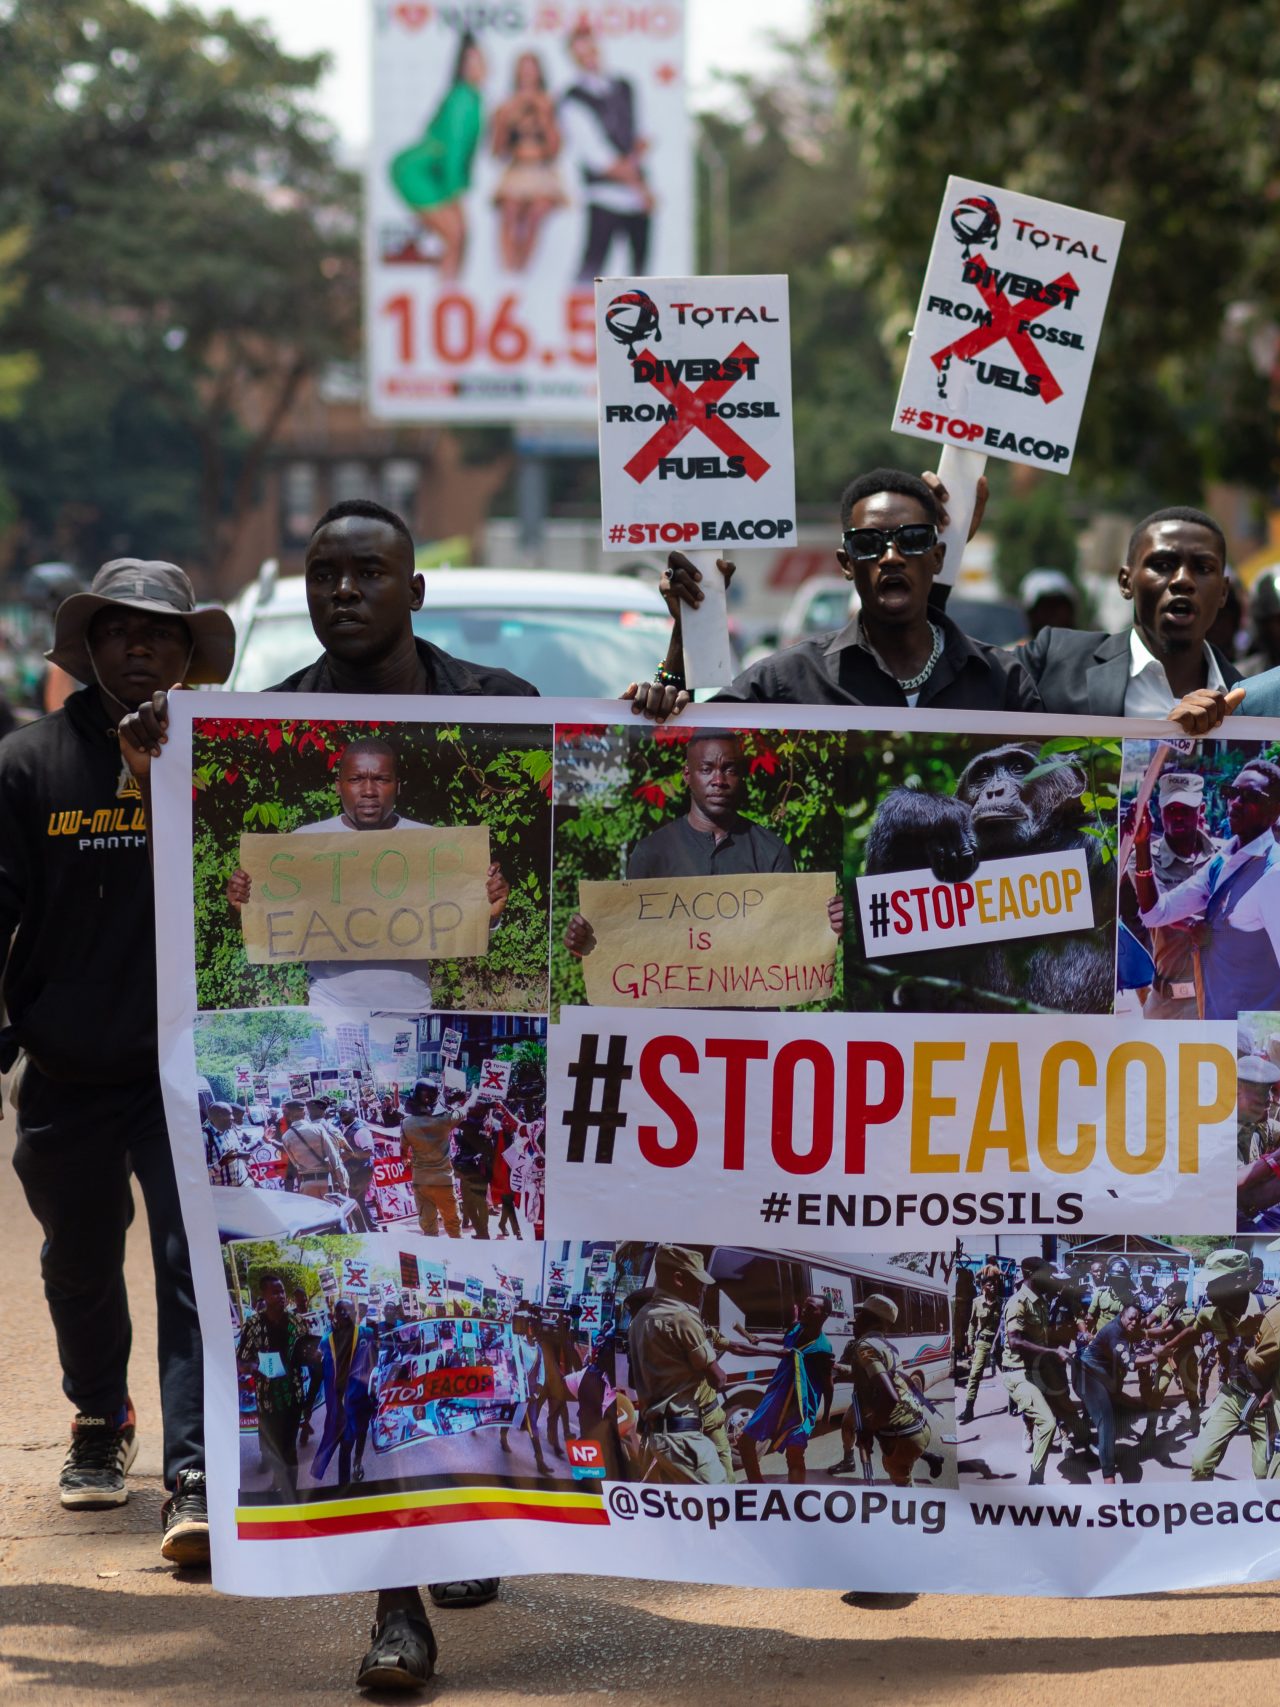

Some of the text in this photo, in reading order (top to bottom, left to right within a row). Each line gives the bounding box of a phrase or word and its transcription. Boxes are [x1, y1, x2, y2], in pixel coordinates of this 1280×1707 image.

[1012, 217, 1108, 264] TOTAL
[961, 262, 1080, 310] DIVERST
[381, 294, 596, 365] 106.5
[670, 302, 779, 328] TOTAL
[926, 295, 1086, 351] FROM FOSSIL
[632, 357, 760, 389] DIVERST
[963, 357, 1042, 397] UELS
[606, 401, 780, 425] FROM FOSSIL
[899, 406, 1070, 463] #STOPEACOP
[658, 455, 747, 480] FUELS
[608, 519, 793, 544] #STOPEACOP
[261, 842, 465, 905] STOP
[638, 888, 764, 921] EACOP
[869, 868, 1082, 939] #STOPEACOP
[267, 902, 463, 958] EACOP
[688, 927, 712, 951] is
[612, 962, 835, 999] GREENWASHING
[562, 1033, 1237, 1175] #STOPEACOP
[374, 1162, 405, 1182] STOP
[760, 1191, 1084, 1227] #ENDFOSSILS
[430, 1373, 494, 1397] EACOP
[572, 1446, 597, 1462] NP
[608, 1484, 946, 1535] @StopEACOPug
